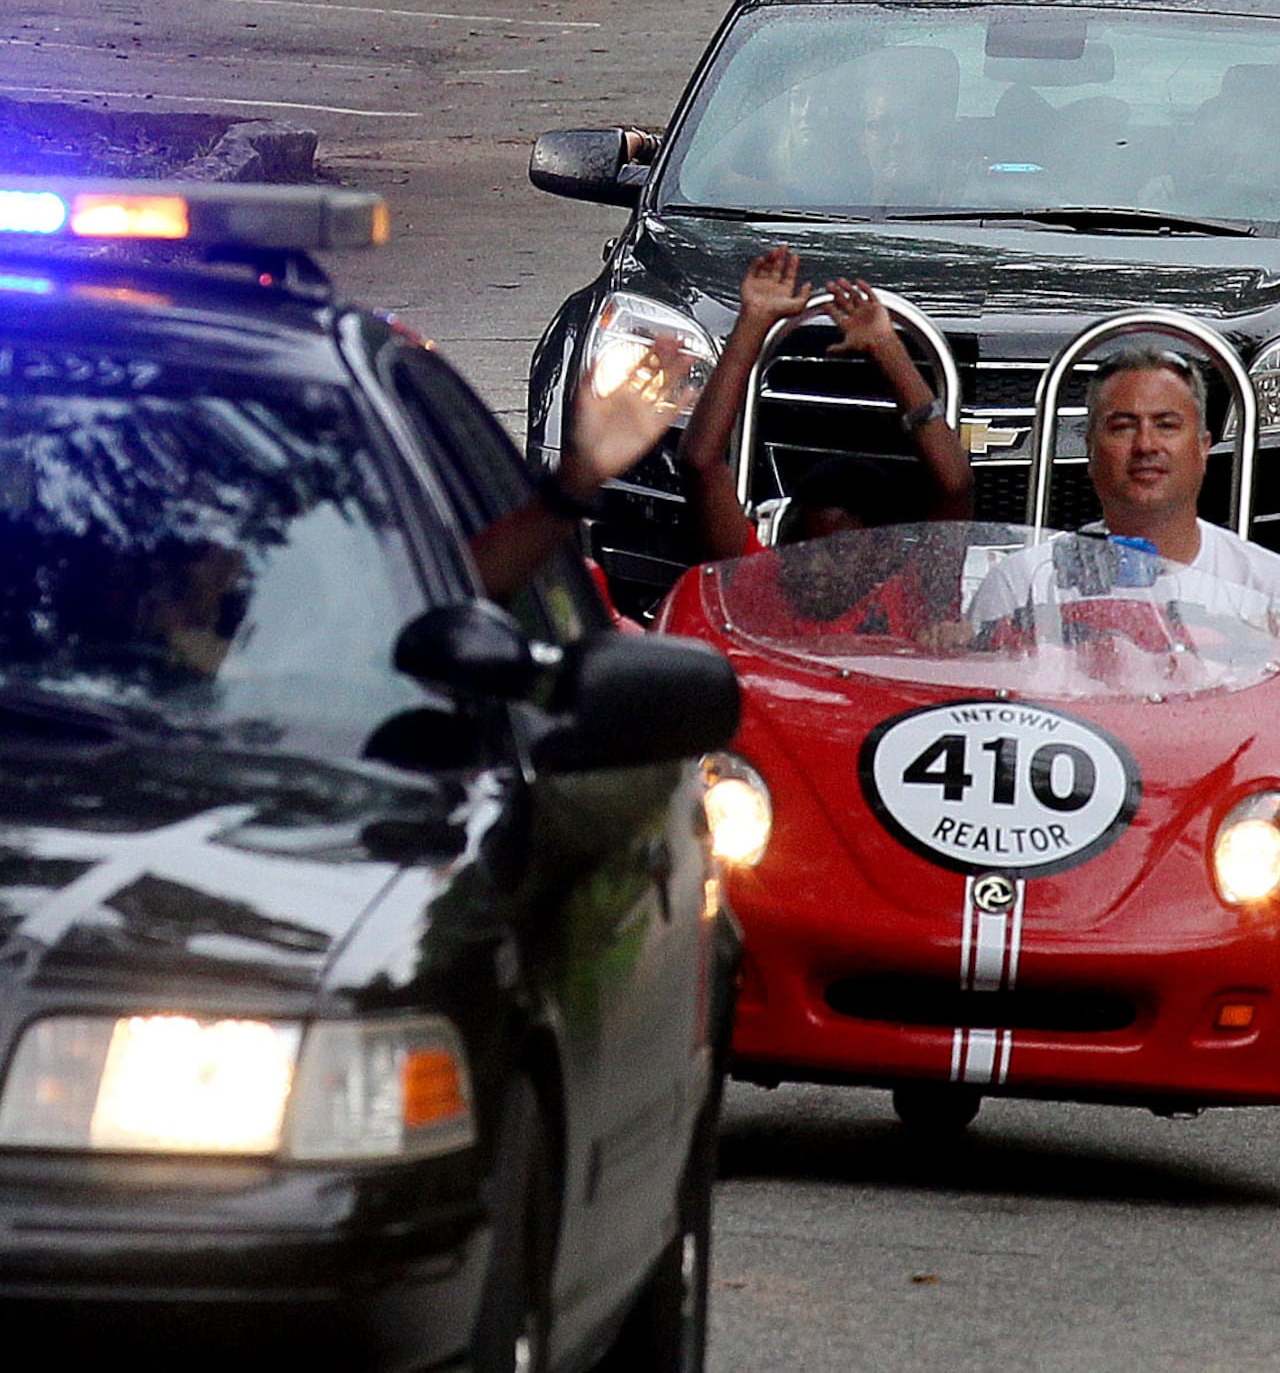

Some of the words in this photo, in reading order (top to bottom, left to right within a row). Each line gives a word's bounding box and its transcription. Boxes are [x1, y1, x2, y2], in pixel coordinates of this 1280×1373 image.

[951, 708, 1061, 732] INTOWN
[901, 733, 1097, 812] 410
[931, 816, 1071, 854] REALTOR
